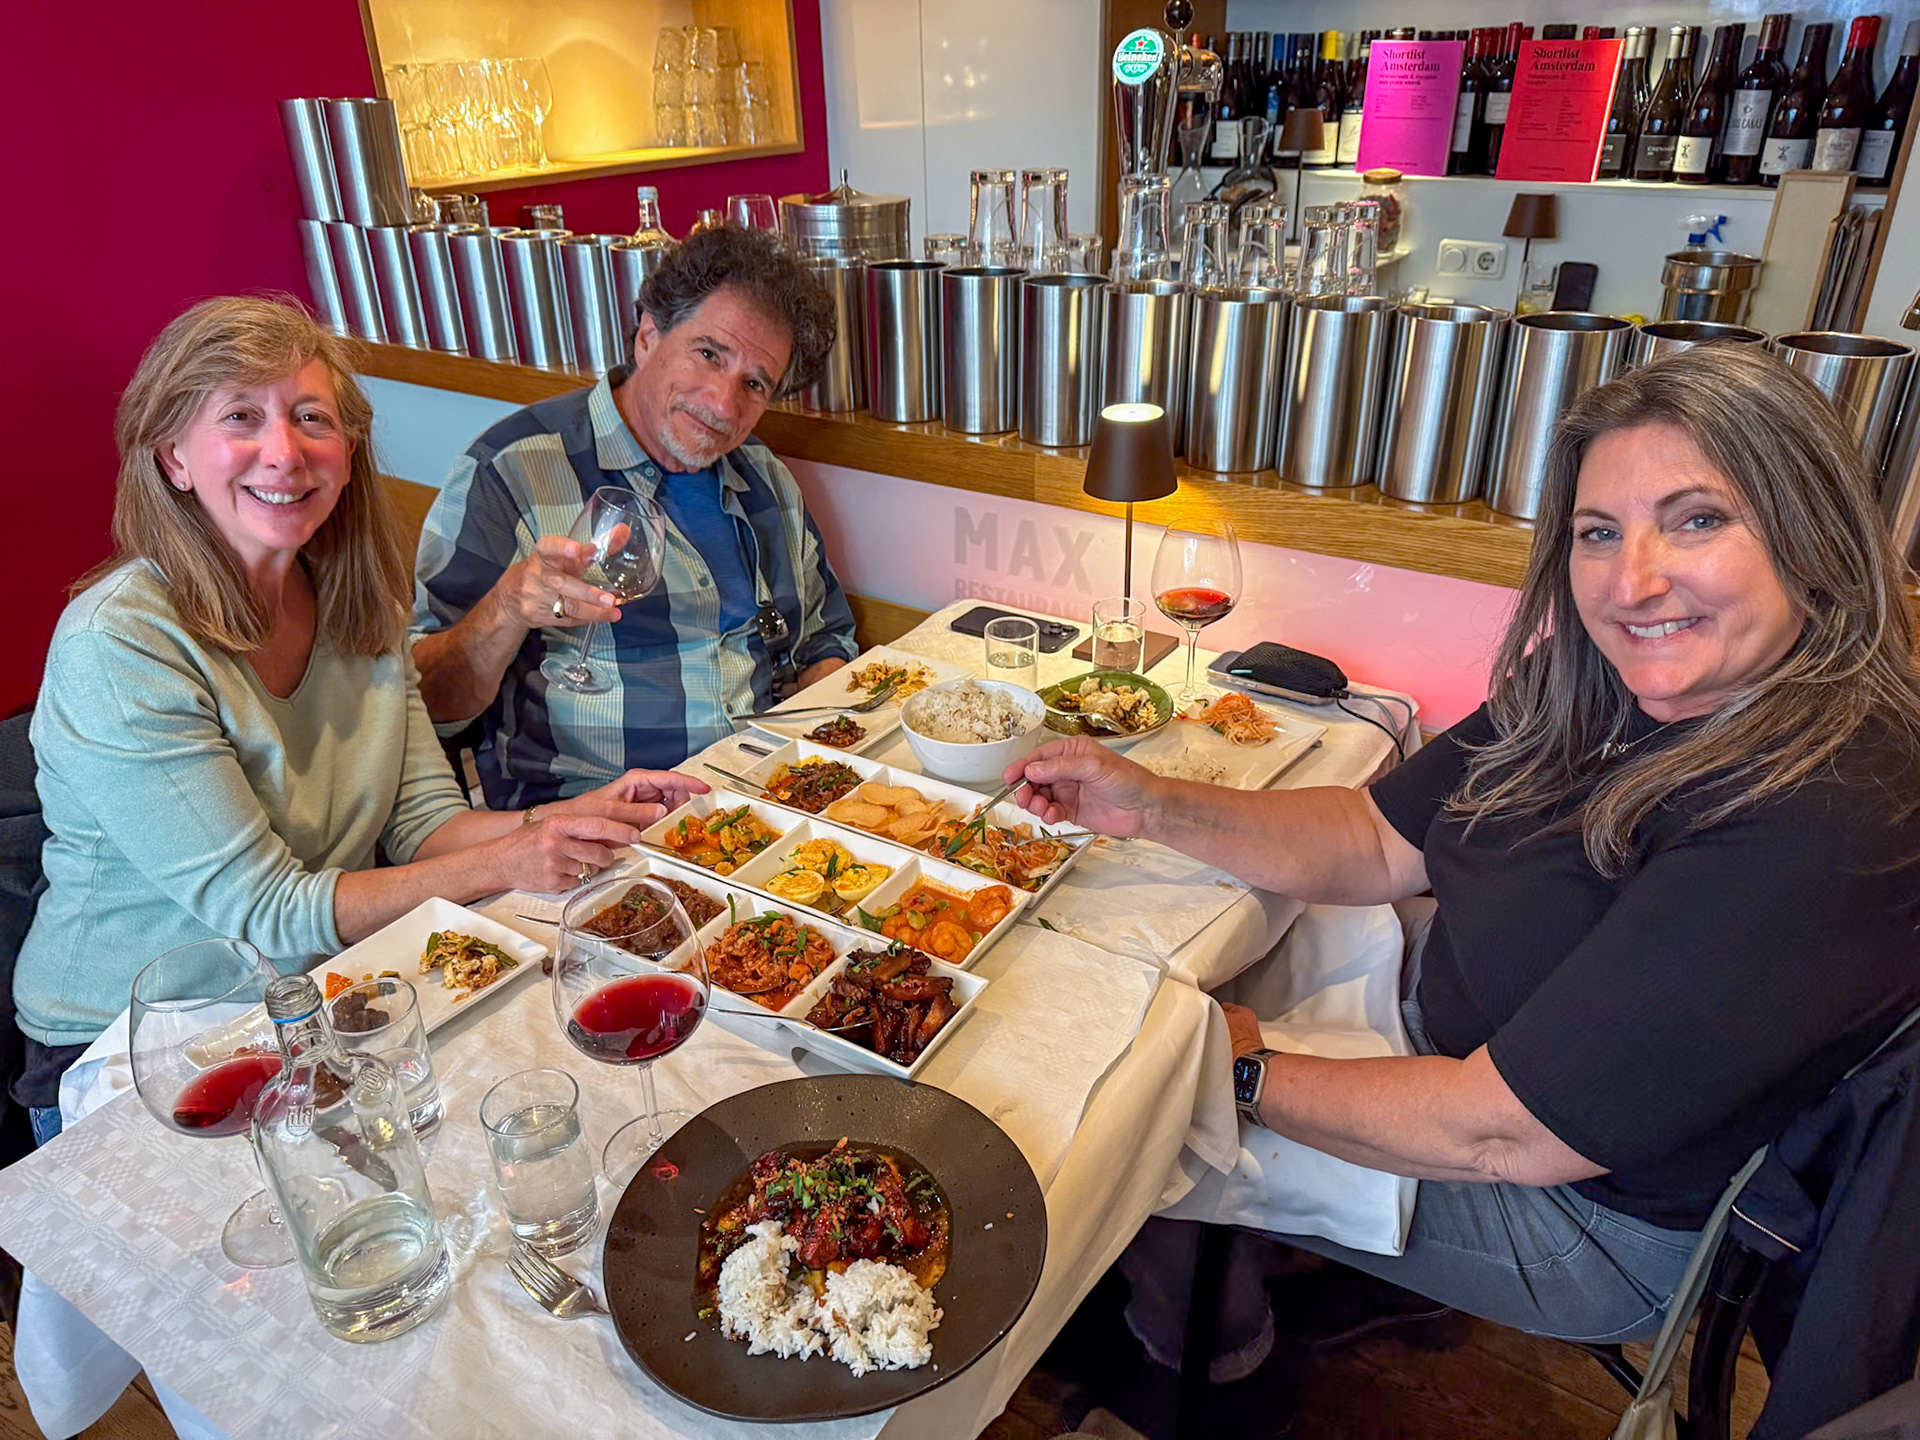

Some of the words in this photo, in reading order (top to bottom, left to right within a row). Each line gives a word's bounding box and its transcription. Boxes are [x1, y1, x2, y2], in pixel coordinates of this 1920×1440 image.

[1118, 51, 1159, 62] Heineken
[1383, 49, 1425, 59] Shortlist
[1533, 47, 1580, 59] Shortlist
[1381, 61, 1440, 71] Amsterdam
[1531, 61, 1596, 71] Amsterdam
[954, 505, 1096, 596] MAX
